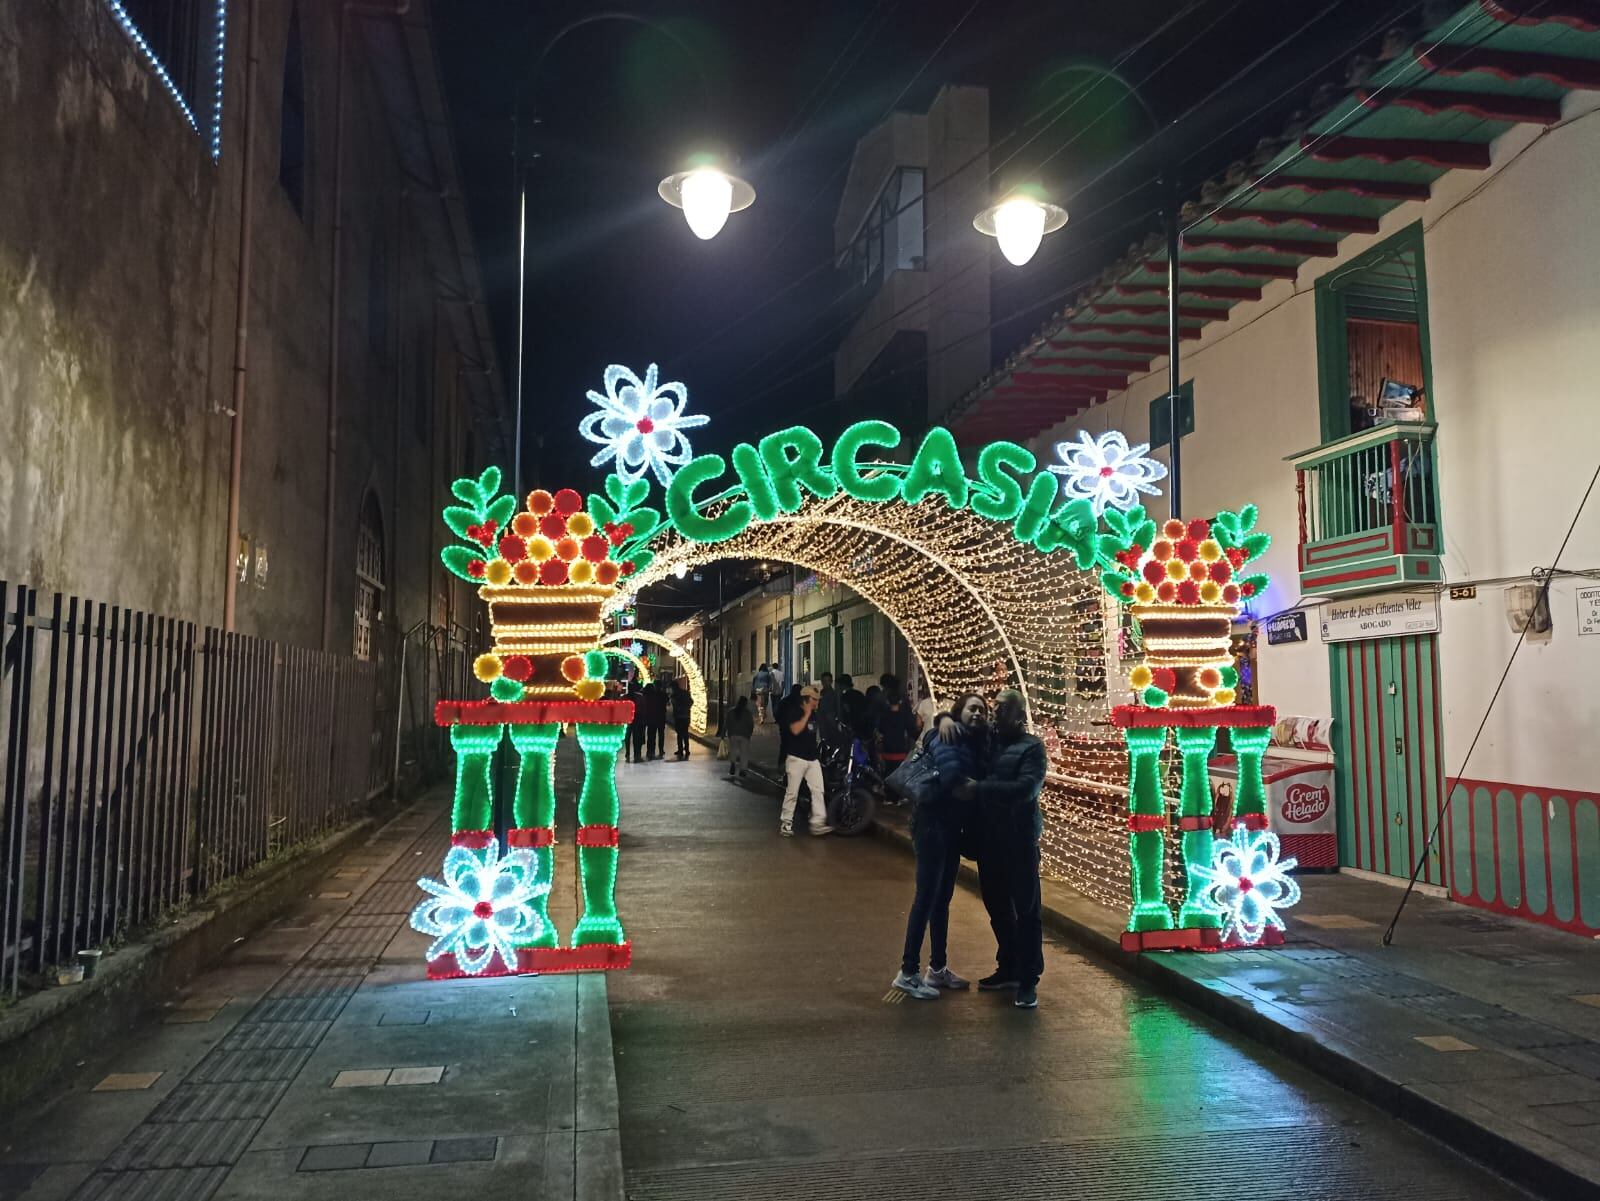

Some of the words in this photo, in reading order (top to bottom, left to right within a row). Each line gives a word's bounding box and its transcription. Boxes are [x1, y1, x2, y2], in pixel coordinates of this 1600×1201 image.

[666, 419, 1098, 570] CIRCASIA
[1349, 607, 1356, 618] de
[1375, 602, 1404, 615] Cifuentes
[1360, 620, 1391, 630] ABOGADO
[1290, 788, 1321, 804] Crem
[1286, 800, 1325, 820] Helado
